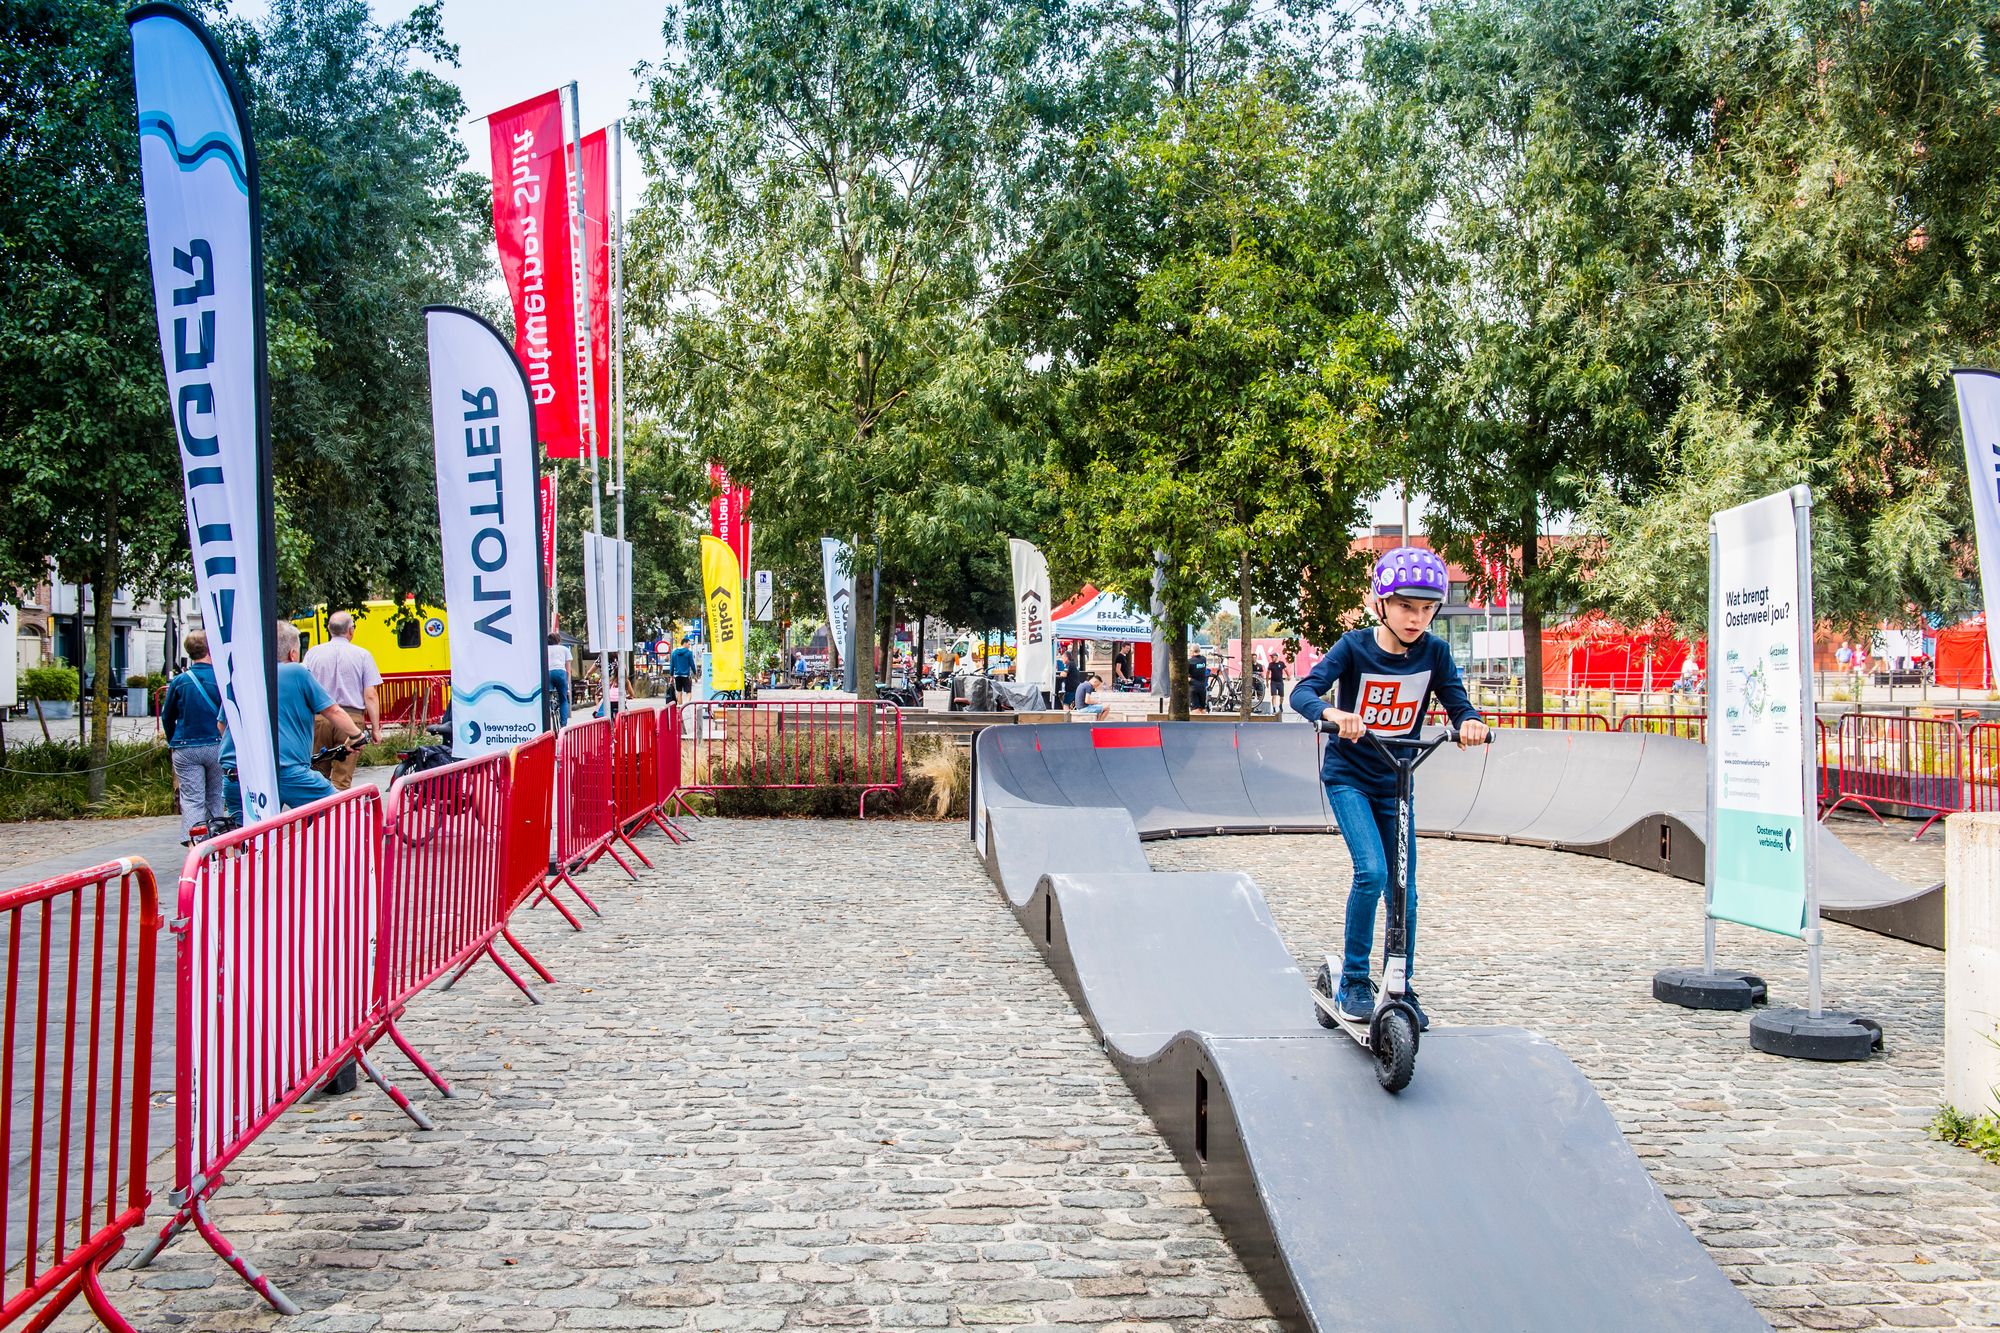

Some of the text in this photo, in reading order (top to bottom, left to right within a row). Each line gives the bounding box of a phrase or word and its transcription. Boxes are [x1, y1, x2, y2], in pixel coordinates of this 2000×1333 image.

[1725, 586, 1769, 607] Wat brengt
[1725, 602, 1790, 628] Oosterweel jou?
[1368, 685, 1395, 706] BE
[1363, 706, 1414, 727] BOLD
[1756, 825, 1784, 838] Oosterweel
[1758, 838, 1784, 852] verbinding
